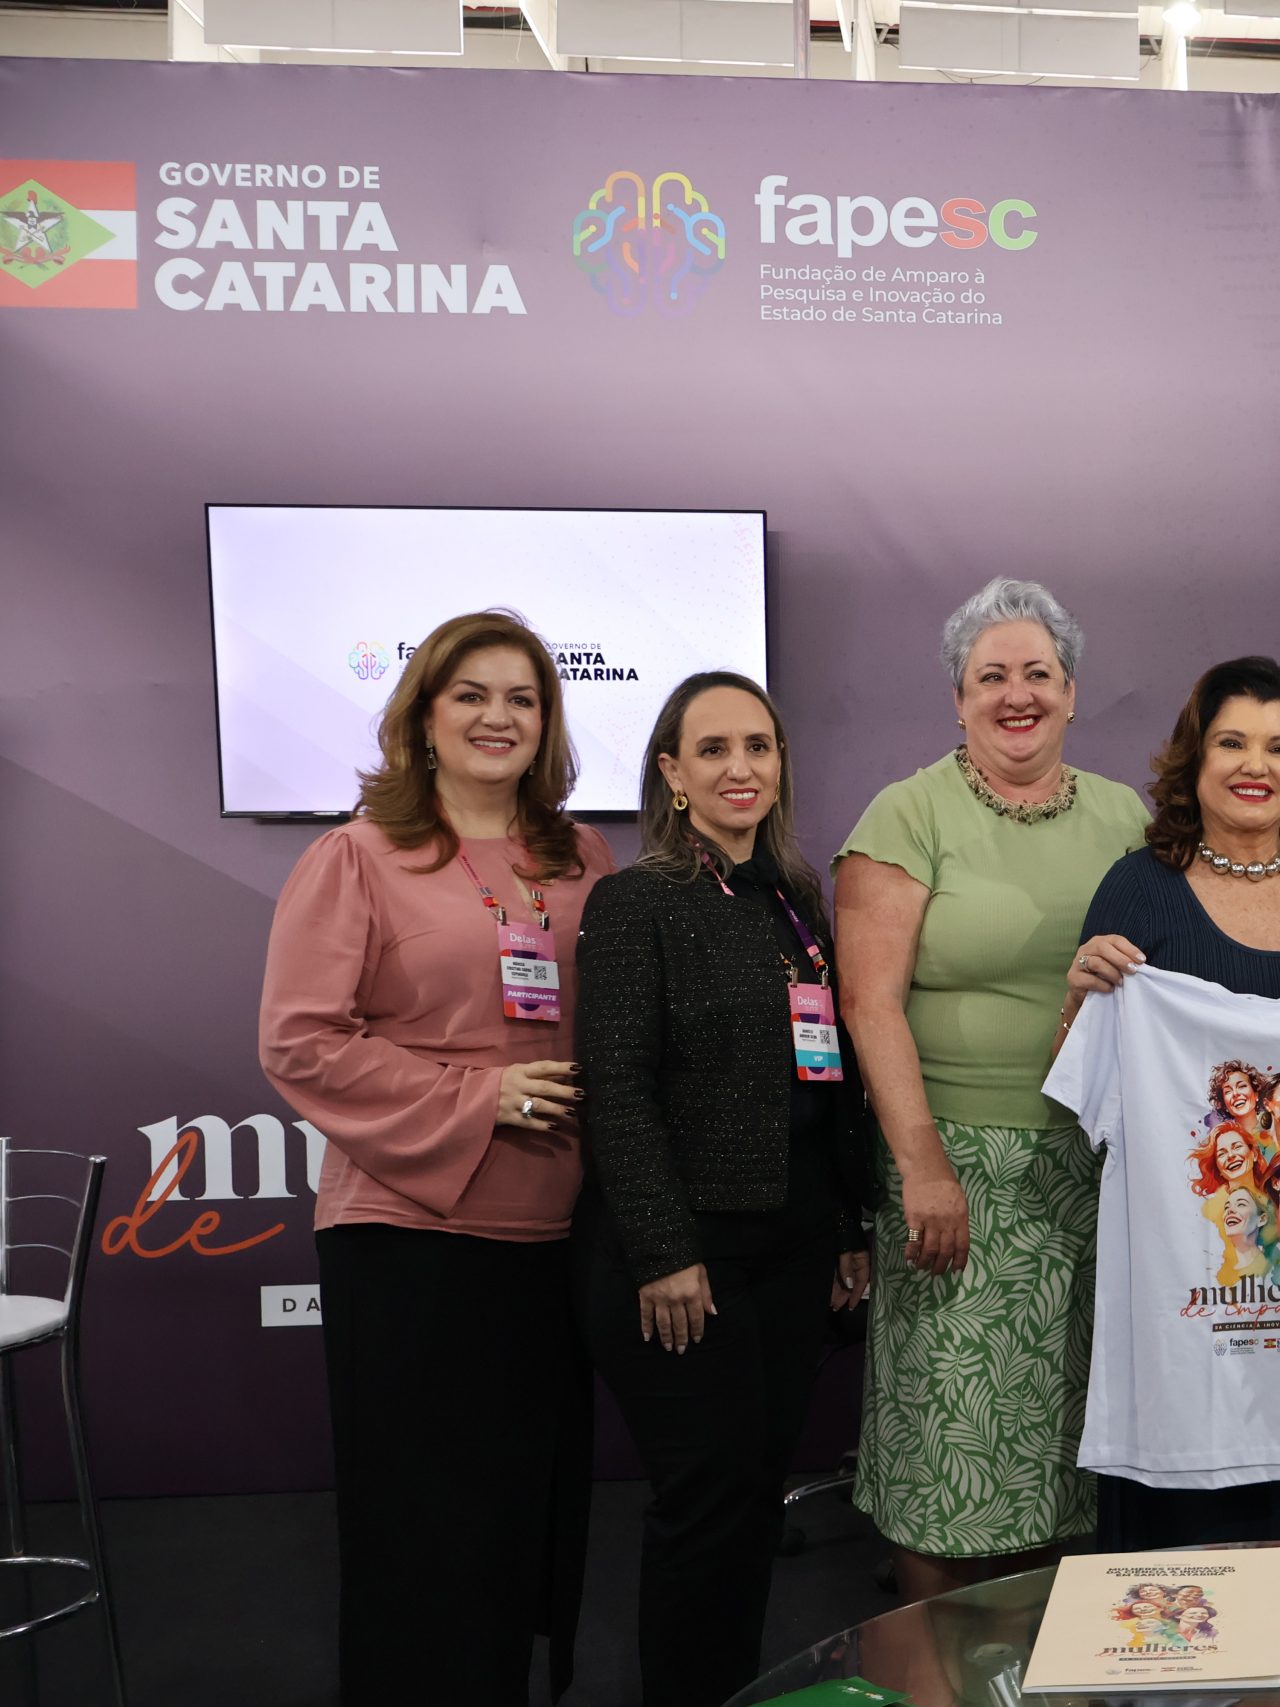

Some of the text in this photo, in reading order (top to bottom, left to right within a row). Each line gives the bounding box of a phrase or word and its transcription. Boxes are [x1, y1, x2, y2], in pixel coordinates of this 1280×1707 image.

[159, 161, 380, 189] GOVERNO DE
[154, 197, 399, 251] SANTA
[754, 174, 1038, 258] fapesc
[154, 257, 528, 314] CATARINA
[760, 264, 985, 286] Fundação de Amparo à
[760, 285, 985, 307] Pesquisa e Inovação do
[760, 305, 1003, 325] Estado de Santa Catarina
[553, 652, 606, 665] ANTA
[560, 667, 640, 681] ATARINA
[510, 933, 536, 944] Delas
[508, 991, 556, 1001] PARTICIPANTE
[797, 996, 818, 1006] Delas
[102, 1131, 285, 1258] de
[282, 1297, 321, 1313] DA
[1180, 1290, 1216, 1318] de
[1229, 1338, 1259, 1347] fapesc
